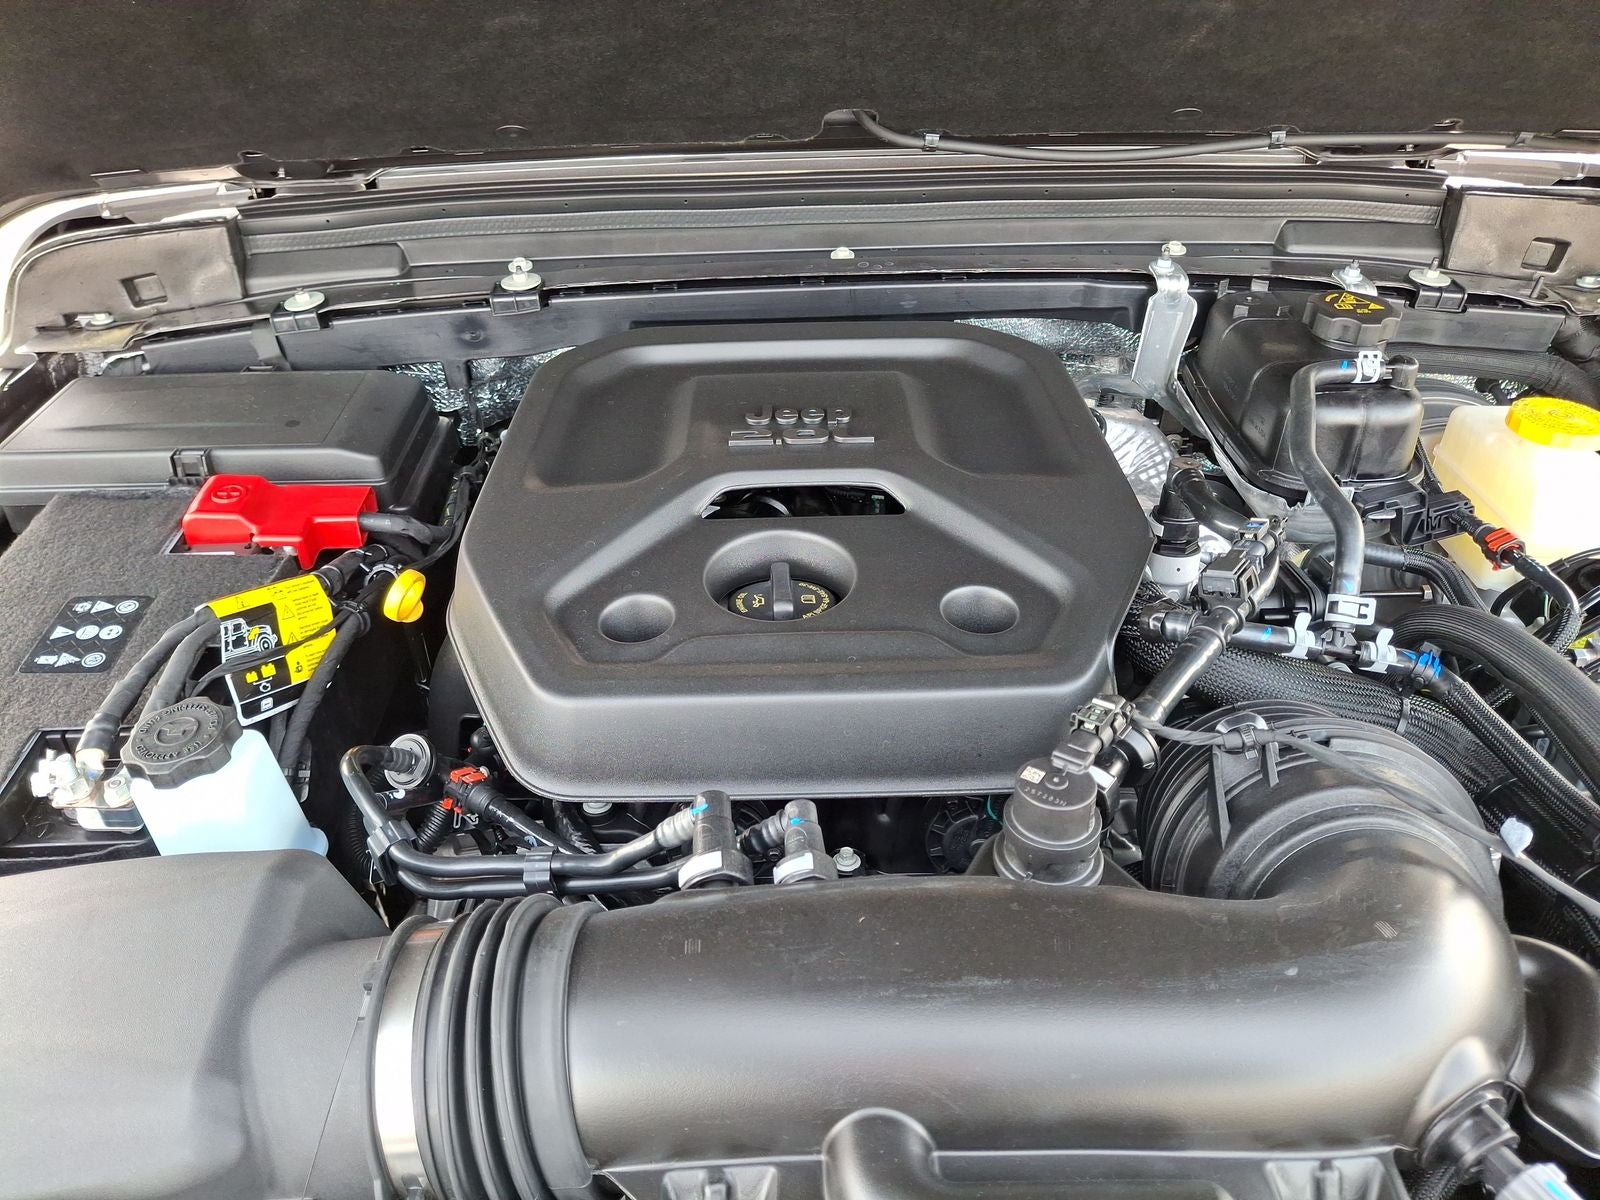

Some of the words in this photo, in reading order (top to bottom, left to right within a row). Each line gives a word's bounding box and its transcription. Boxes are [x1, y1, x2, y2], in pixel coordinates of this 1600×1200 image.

[745, 406, 851, 427] Jeep
[728, 428, 875, 447] 2.0L
[135, 743, 181, 760] APPROVED
